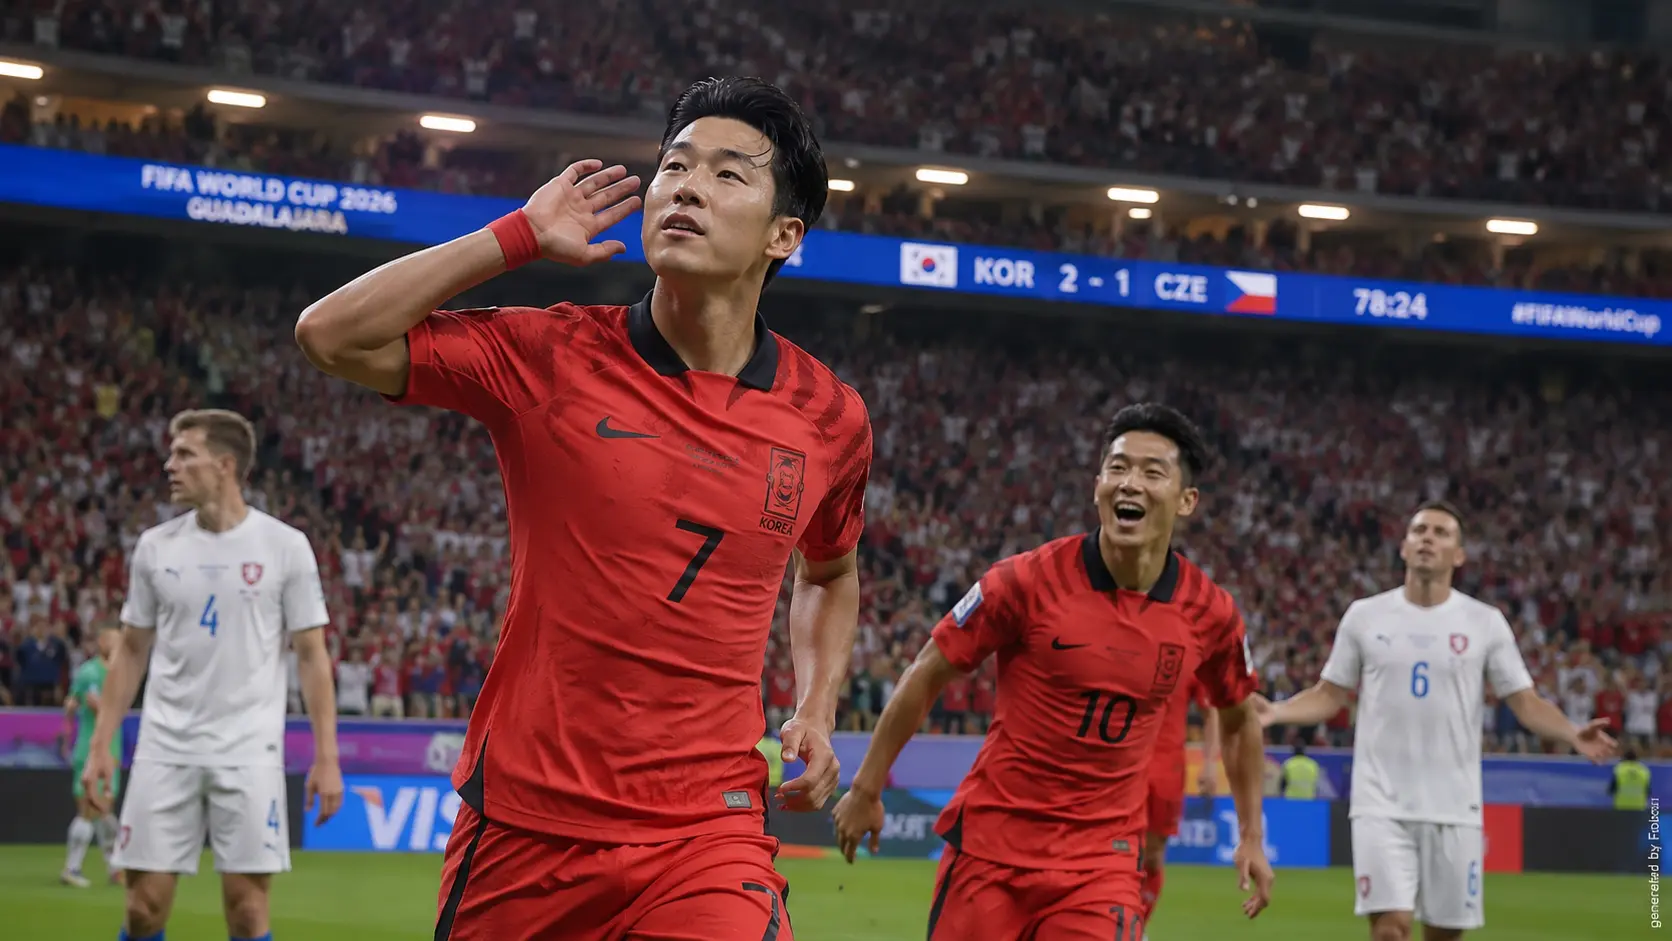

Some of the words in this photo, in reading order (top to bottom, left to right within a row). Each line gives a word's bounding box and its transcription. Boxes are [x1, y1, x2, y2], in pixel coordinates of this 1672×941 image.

[141, 164, 194, 193] FIFA
[197, 171, 283, 202] WORLD
[287, 181, 337, 207] CUP
[339, 187, 398, 214] 2026
[187, 197, 347, 234] GUADALAJARA
[974, 257, 1035, 288] KOR
[1059, 263, 1078, 293] 2
[1114, 268, 1130, 297] 1
[1154, 272, 1209, 303] CZE
[1353, 287, 1428, 320] 78:24
[759, 516, 793, 536] KOREA
[666, 518, 725, 603] 7
[199, 593, 218, 637] 4
[1411, 661, 1430, 699] 6
[1077, 689, 1137, 744] 10
[266, 799, 280, 836] 4
[1467, 859, 1479, 896] 6
[741, 881, 780, 941] 7
